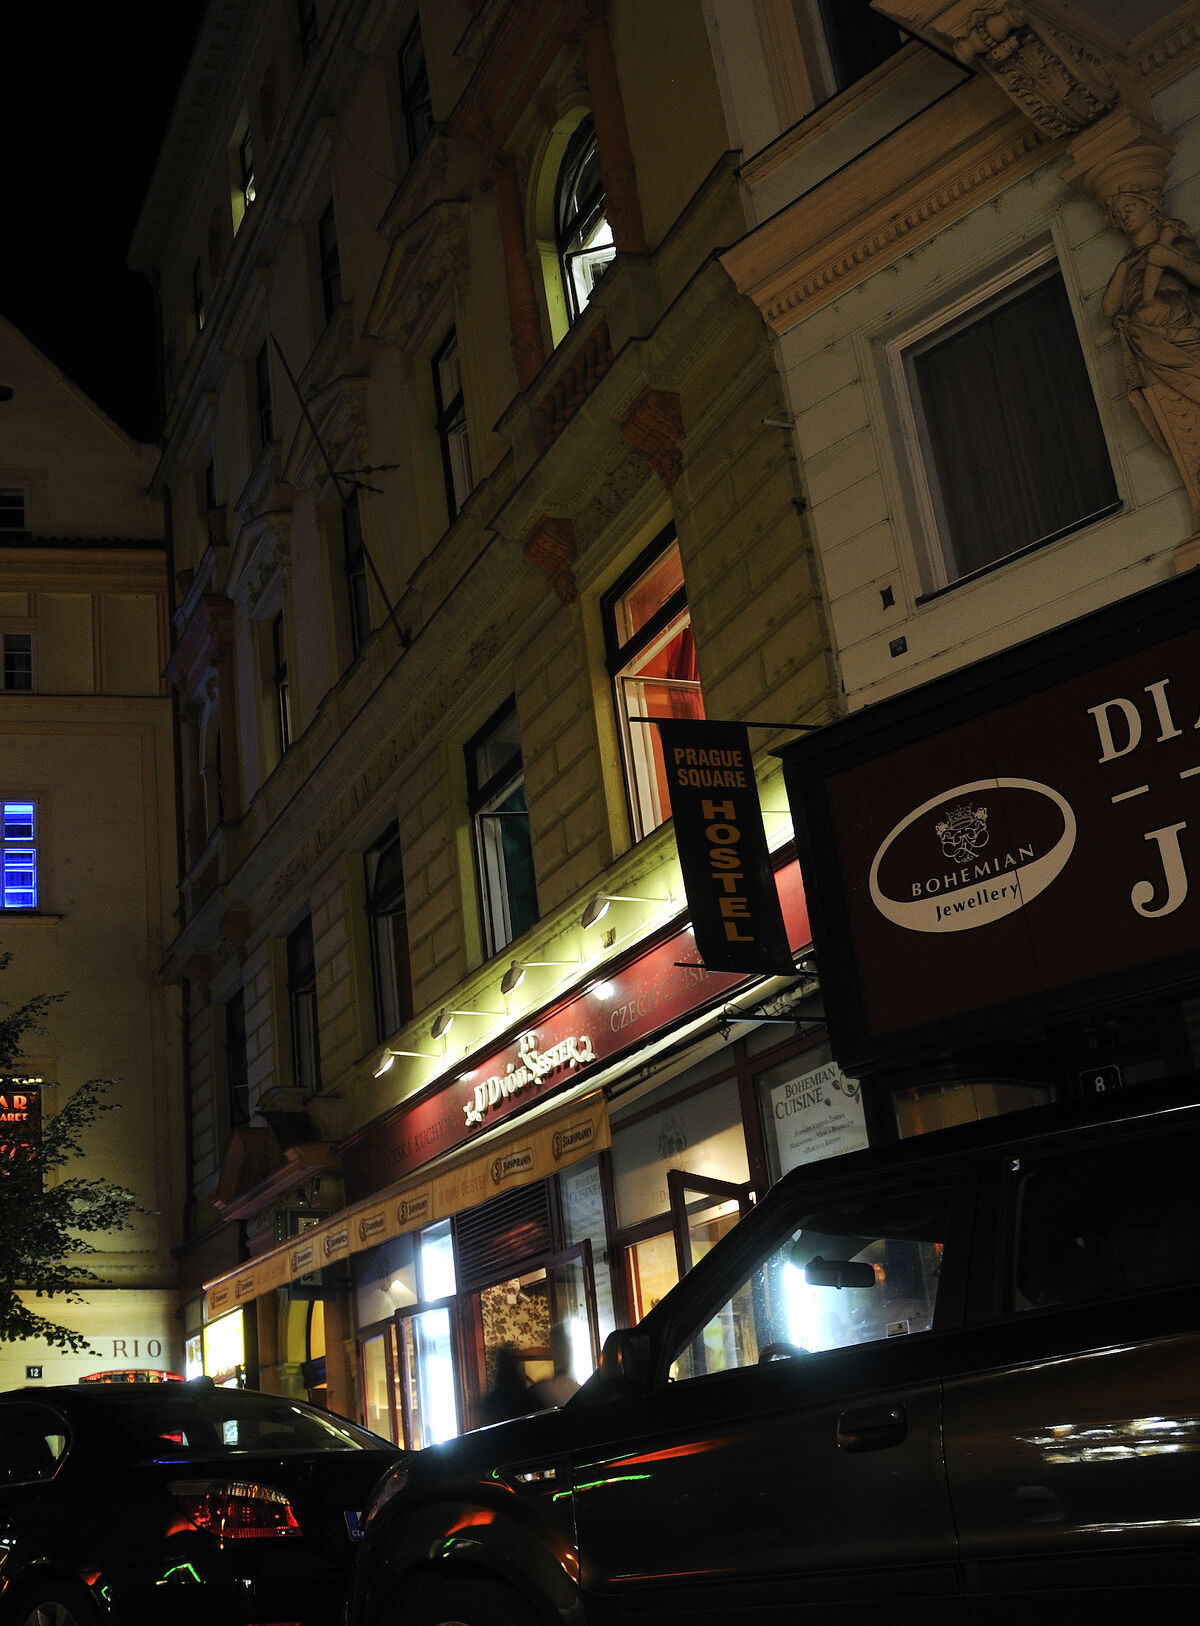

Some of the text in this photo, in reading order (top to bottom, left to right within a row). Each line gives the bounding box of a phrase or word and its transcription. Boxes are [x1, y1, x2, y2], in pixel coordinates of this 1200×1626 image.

[1087, 678, 1200, 764] DI
[673, 747, 744, 768] PRAGUE
[677, 768, 748, 788] SQUARE
[701, 799, 754, 942] HOSTEL
[911, 843, 1035, 897] BOHEMIAN
[935, 882, 1019, 922] Jewellery
[610, 964, 709, 1033] CZECH CUISI
[784, 1066, 837, 1099] BOHEMIAN
[1094, 1075, 1106, 1092] 8
[774, 1087, 824, 1120] CUISINE
[112, 1339, 162, 1358] RIO
[29, 1367, 39, 1378] 12
